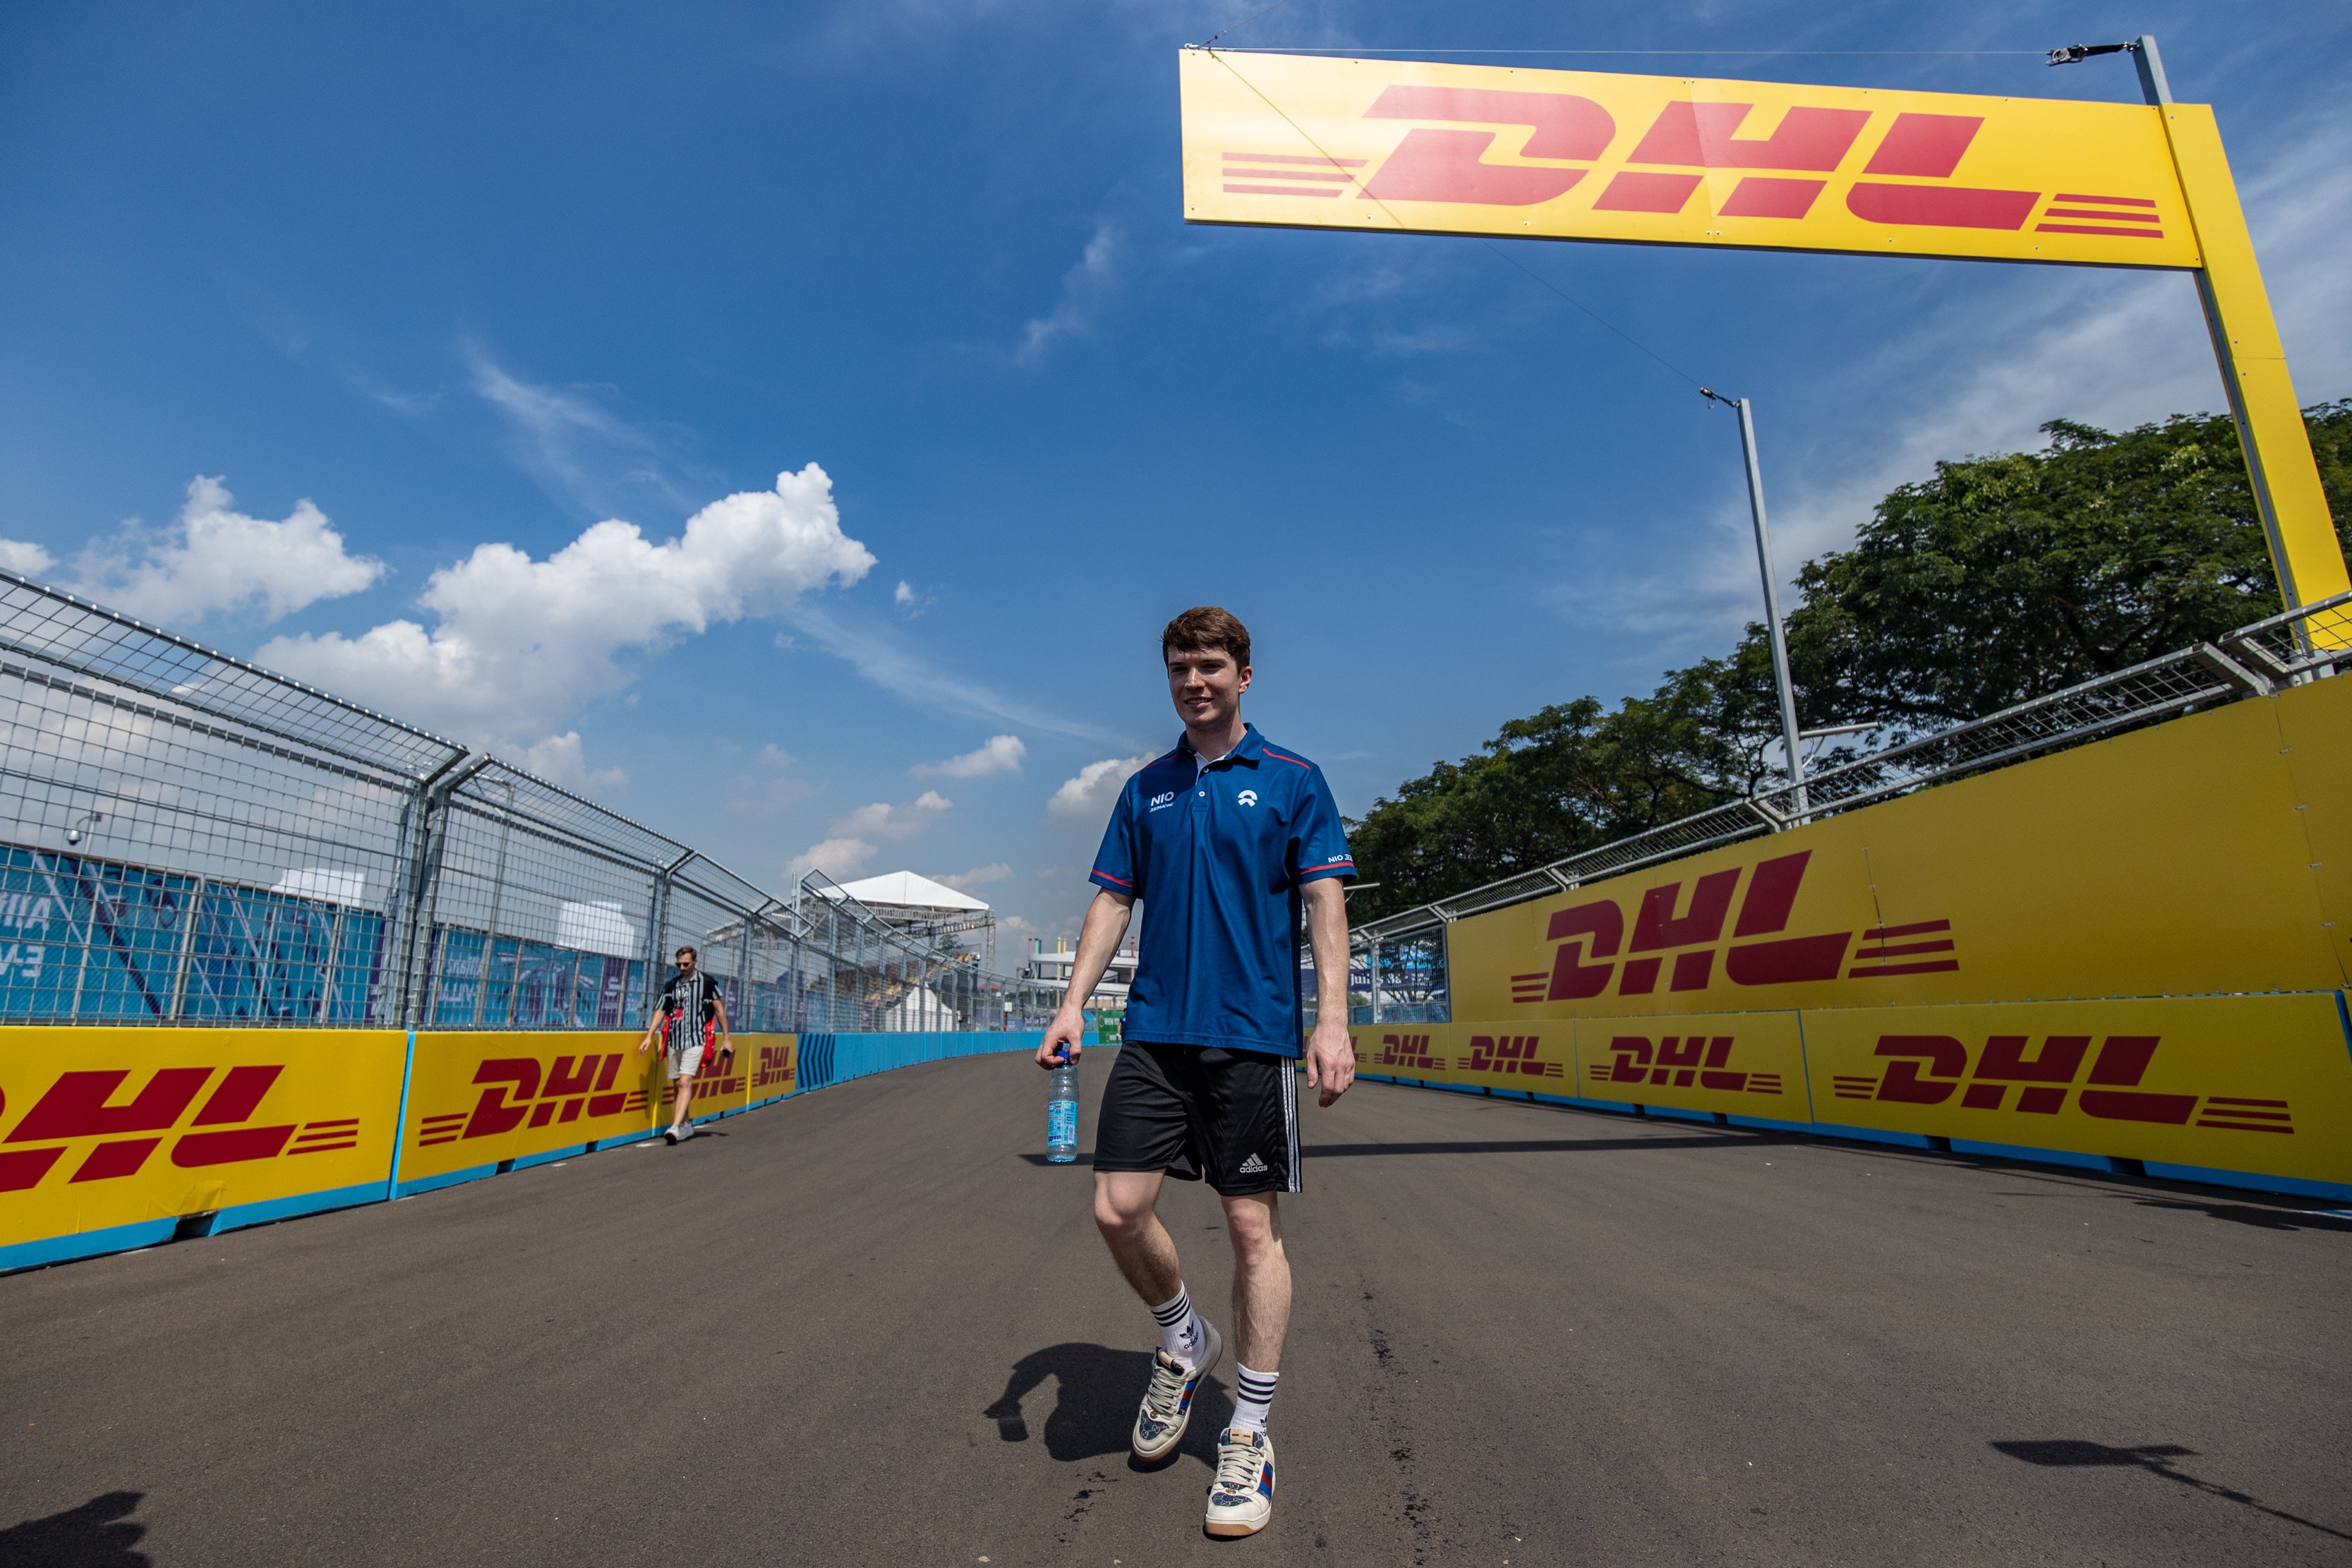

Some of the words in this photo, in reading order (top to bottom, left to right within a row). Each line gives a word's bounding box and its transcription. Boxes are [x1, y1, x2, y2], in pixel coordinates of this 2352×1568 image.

[1356, 84, 2042, 231] DHL
[1150, 791, 1174, 807] NIO
[1327, 855, 1344, 863] NIO
[1546, 849, 1852, 1001] DHL
[690, 1050, 737, 1100] HL
[759, 1047, 791, 1087] DHL
[1382, 1035, 1435, 1070] DHL
[1469, 1035, 1547, 1077] DHL
[1609, 1036, 1749, 1093] DHL
[462, 1054, 628, 1140] DHL
[1873, 1035, 2200, 1126] DHL
[0, 1065, 298, 1193] HL
[1239, 1165, 1268, 1174] adidas
